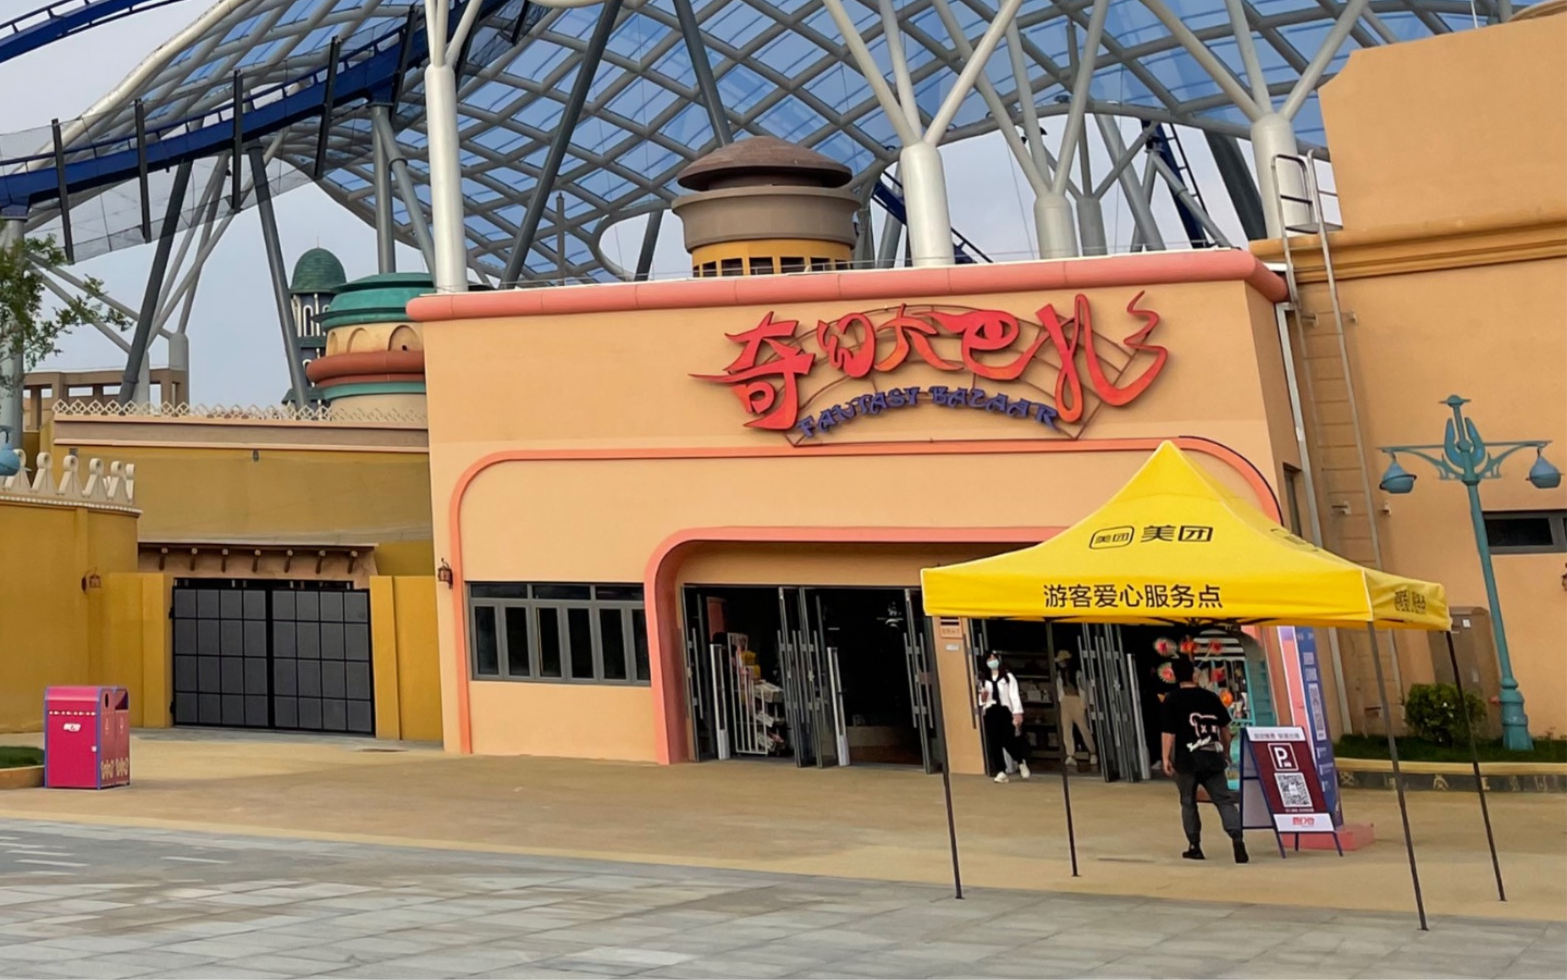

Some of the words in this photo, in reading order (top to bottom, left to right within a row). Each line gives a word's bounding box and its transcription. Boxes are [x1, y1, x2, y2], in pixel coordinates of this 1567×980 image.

[688, 290, 1168, 431] 奇幻大巴扎
[795, 387, 921, 438] FANTASY
[929, 386, 1060, 433] BAZAAR
[1094, 532, 1131, 544] 美团
[1140, 525, 1214, 542] 美团
[1043, 584, 1223, 608] 游客爱心服务点
[1274, 747, 1288, 768] P
